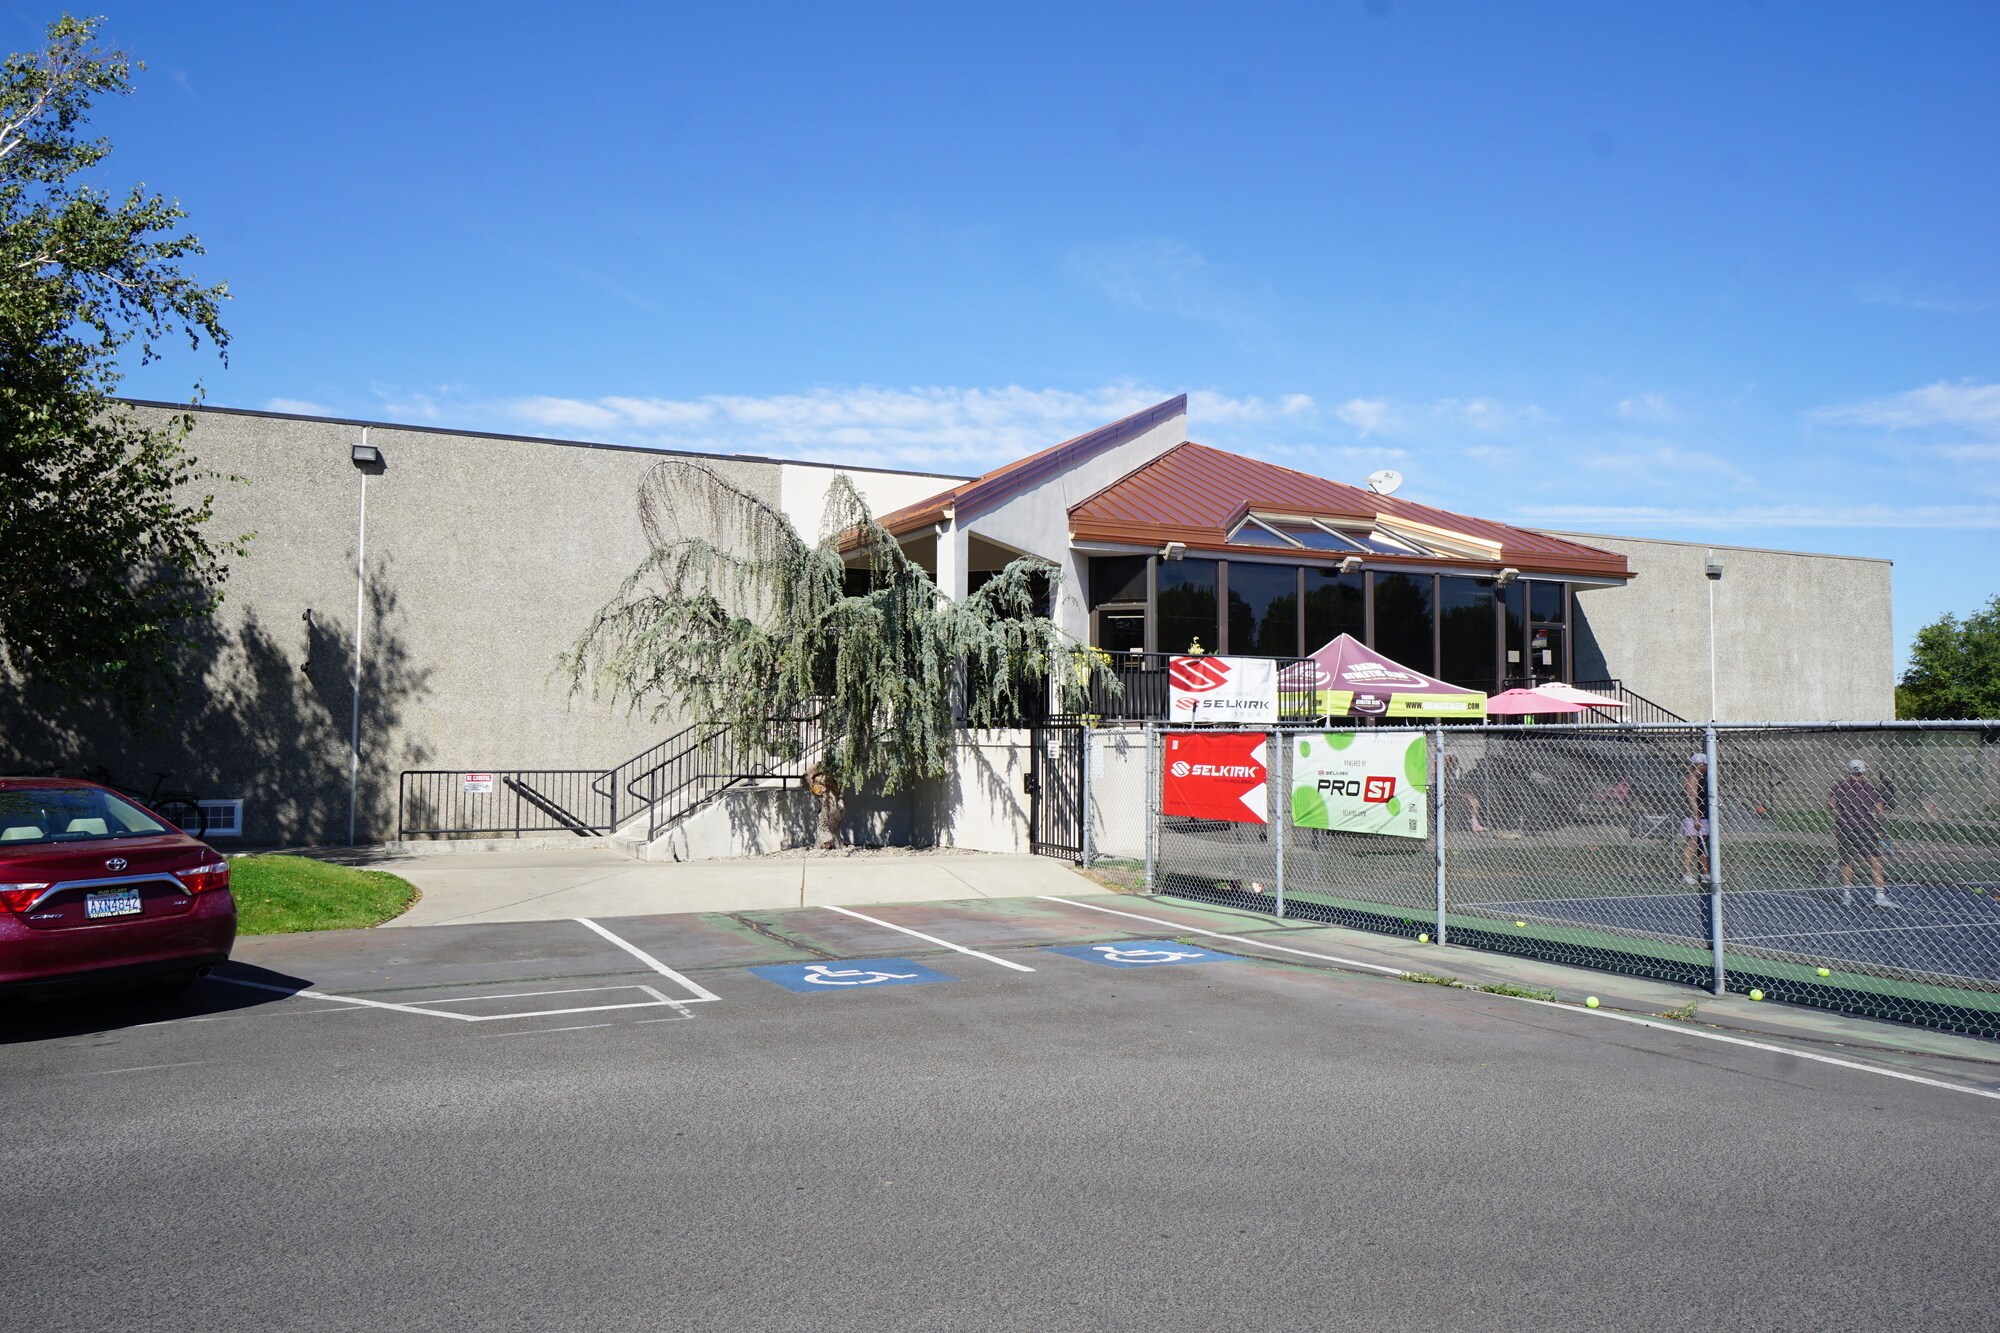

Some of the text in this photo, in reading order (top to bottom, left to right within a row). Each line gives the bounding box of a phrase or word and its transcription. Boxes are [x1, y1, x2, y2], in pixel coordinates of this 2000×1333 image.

[1347, 662, 1387, 672] YAKIMA
[1341, 670, 1386, 680] ATHLETIC
[1383, 670, 1409, 679] CLUB
[1203, 699, 1270, 710] SELKIRK
[1191, 764, 1258, 778] SELKIRK
[1317, 779, 1392, 799] PRO S1
[90, 895, 139, 913] AXN4842
[90, 911, 112, 919] TOYOTA
